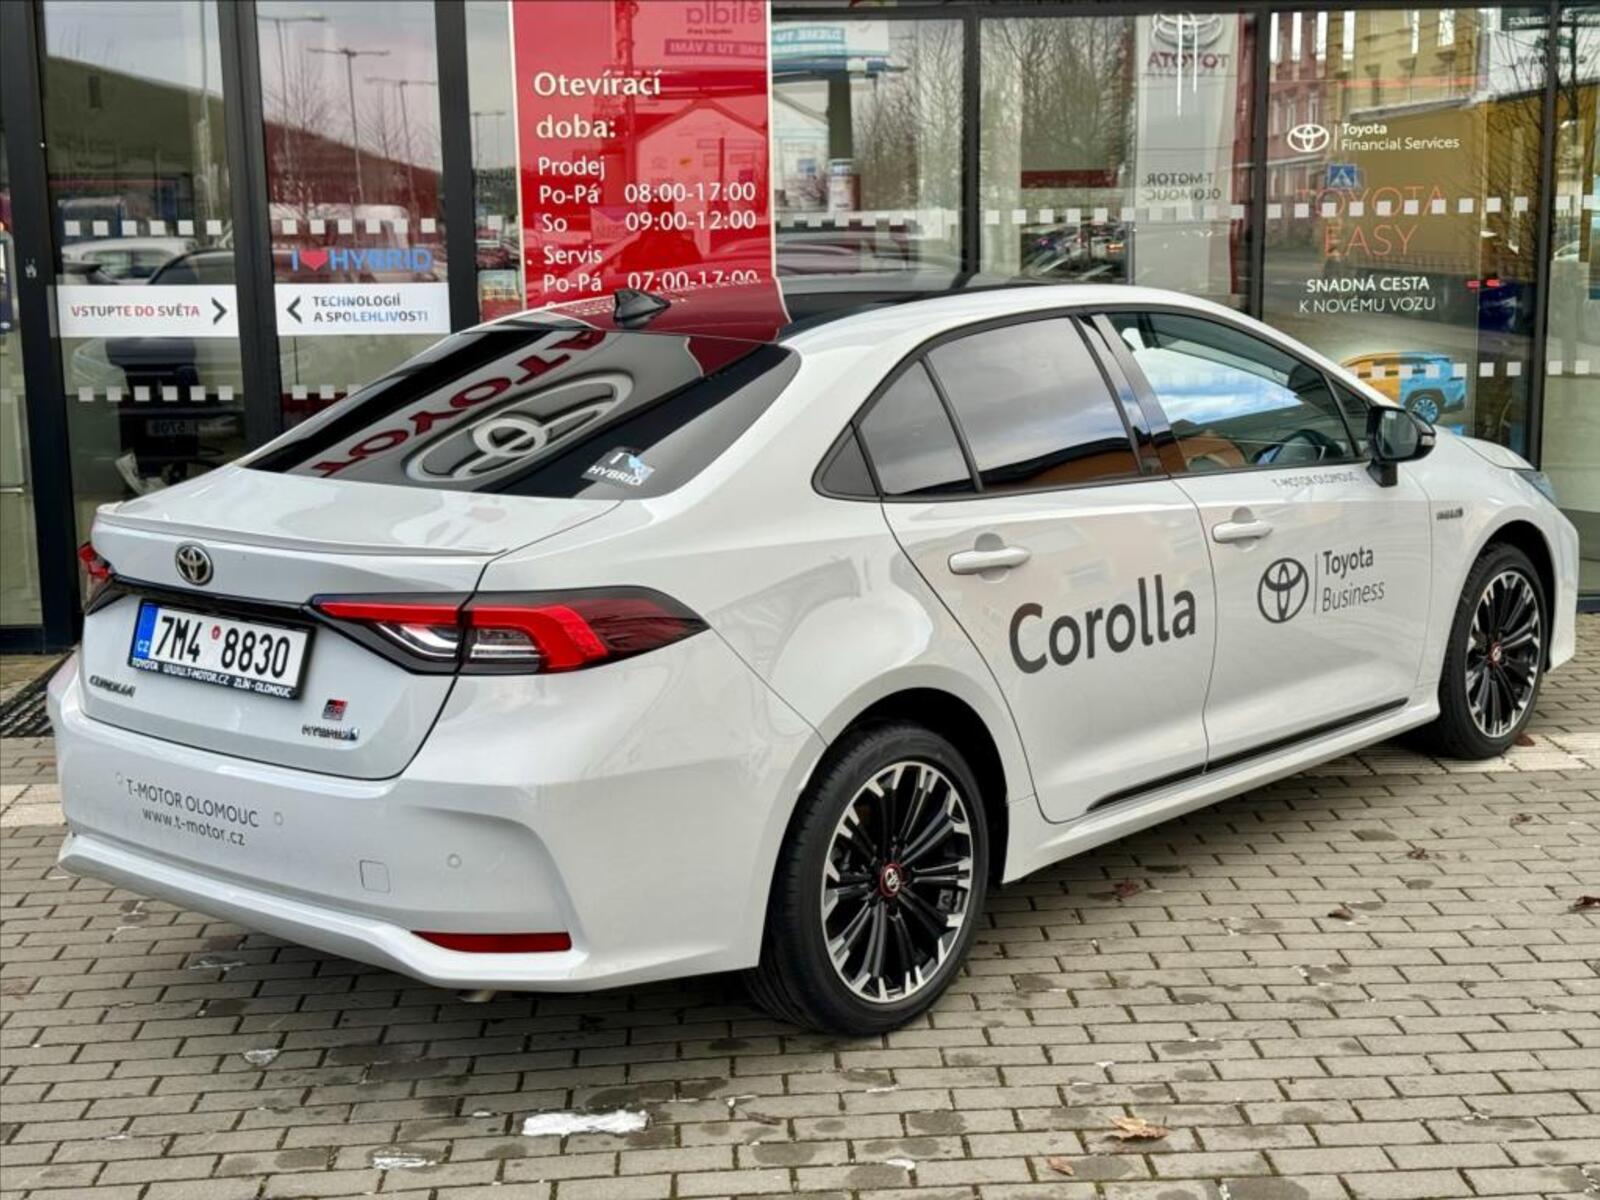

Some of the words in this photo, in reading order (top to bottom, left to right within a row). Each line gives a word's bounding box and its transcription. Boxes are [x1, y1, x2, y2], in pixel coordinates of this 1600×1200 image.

[534, 69, 661, 97] Otevírací
[536, 113, 616, 139] doba:
[1341, 122, 1388, 137] Toyota
[1341, 138, 1401, 152] Financial
[1404, 136, 1461, 150] Services
[538, 155, 605, 180] Prodej
[539, 182, 600, 204] Po-Pá
[624, 182, 757, 203] 08:00-17:00
[1296, 184, 1443, 217] TOYOTA
[541, 212, 568, 233] So
[625, 210, 758, 231] 09:00-12:00
[1324, 223, 1419, 257] EASY
[329, 248, 433, 272] HYBRID
[544, 246, 603, 265] Servis
[544, 273, 602, 293] Po-Pá
[1306, 274, 1376, 293] SNADNÁ
[1380, 275, 1430, 291] CESTA
[71, 305, 132, 317] VSTUPTE
[134, 305, 154, 317] DO
[158, 303, 200, 317] SVĚTA
[313, 292, 401, 307] TECHNOLOGIÍ
[1299, 302, 1310, 313] K
[1314, 295, 1385, 314] NOVÉMU
[1389, 296, 1436, 312] VOZU
[314, 312, 323, 322] A
[326, 310, 428, 322] SPOLEHLIVOSTI
[587, 465, 643, 486] HYBRID
[1322, 547, 1374, 580] Toyota
[1322, 581, 1385, 613] Business
[1009, 574, 1196, 675] Corolla
[137, 640, 150, 652] CZ
[155, 616, 203, 663] 7M4
[220, 627, 291, 679] 8830
[127, 778, 183, 809] T-MOTOR
[185, 795, 260, 828] OLOMOUC
[142, 808, 246, 847] www.t-motor.cz
